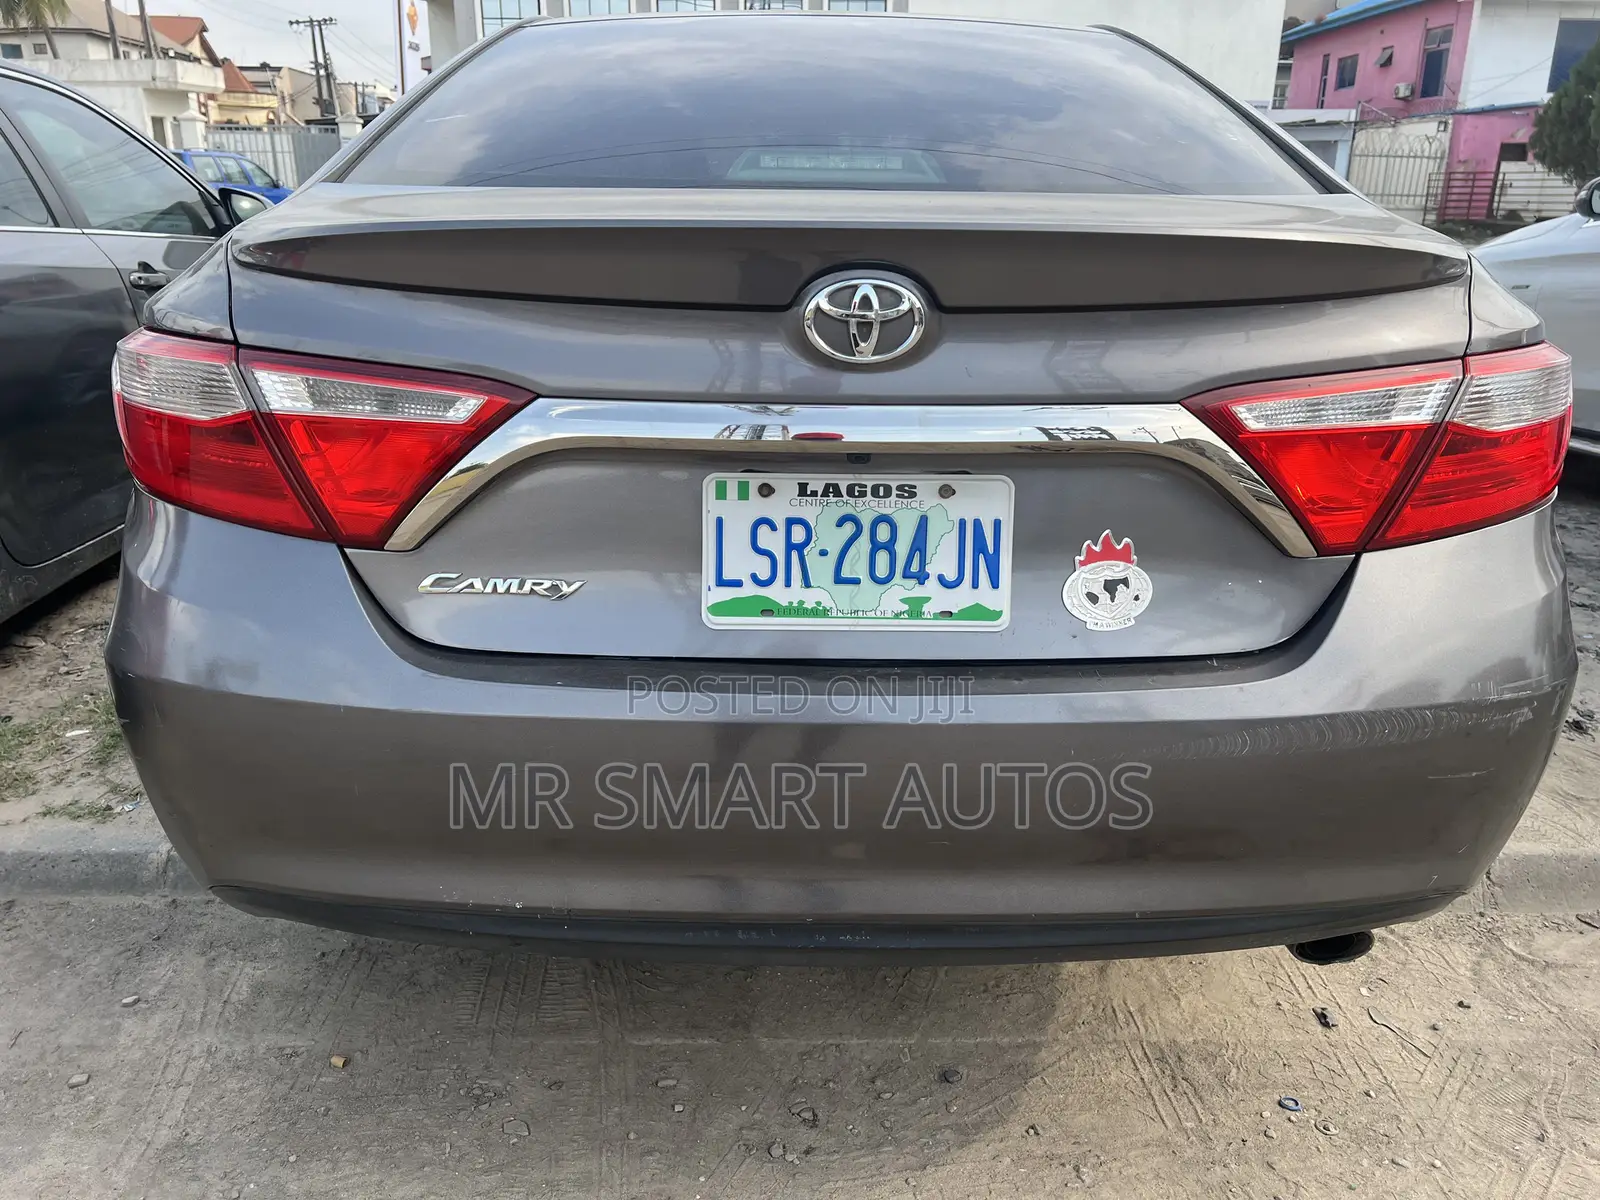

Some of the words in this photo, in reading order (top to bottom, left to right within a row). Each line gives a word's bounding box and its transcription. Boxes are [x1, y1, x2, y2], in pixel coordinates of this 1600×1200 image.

[797, 482, 918, 499] LAGOS
[789, 498, 831, 508] CENTRE
[835, 498, 850, 508] OF
[855, 499, 925, 509] EXCELLENCE
[418, 572, 588, 601] CAMRY
[776, 607, 821, 617] FEDERAL
[823, 608, 873, 617] REPUBLIC
[874, 608, 889, 617] OF
[891, 609, 933, 618] NIGERIA
